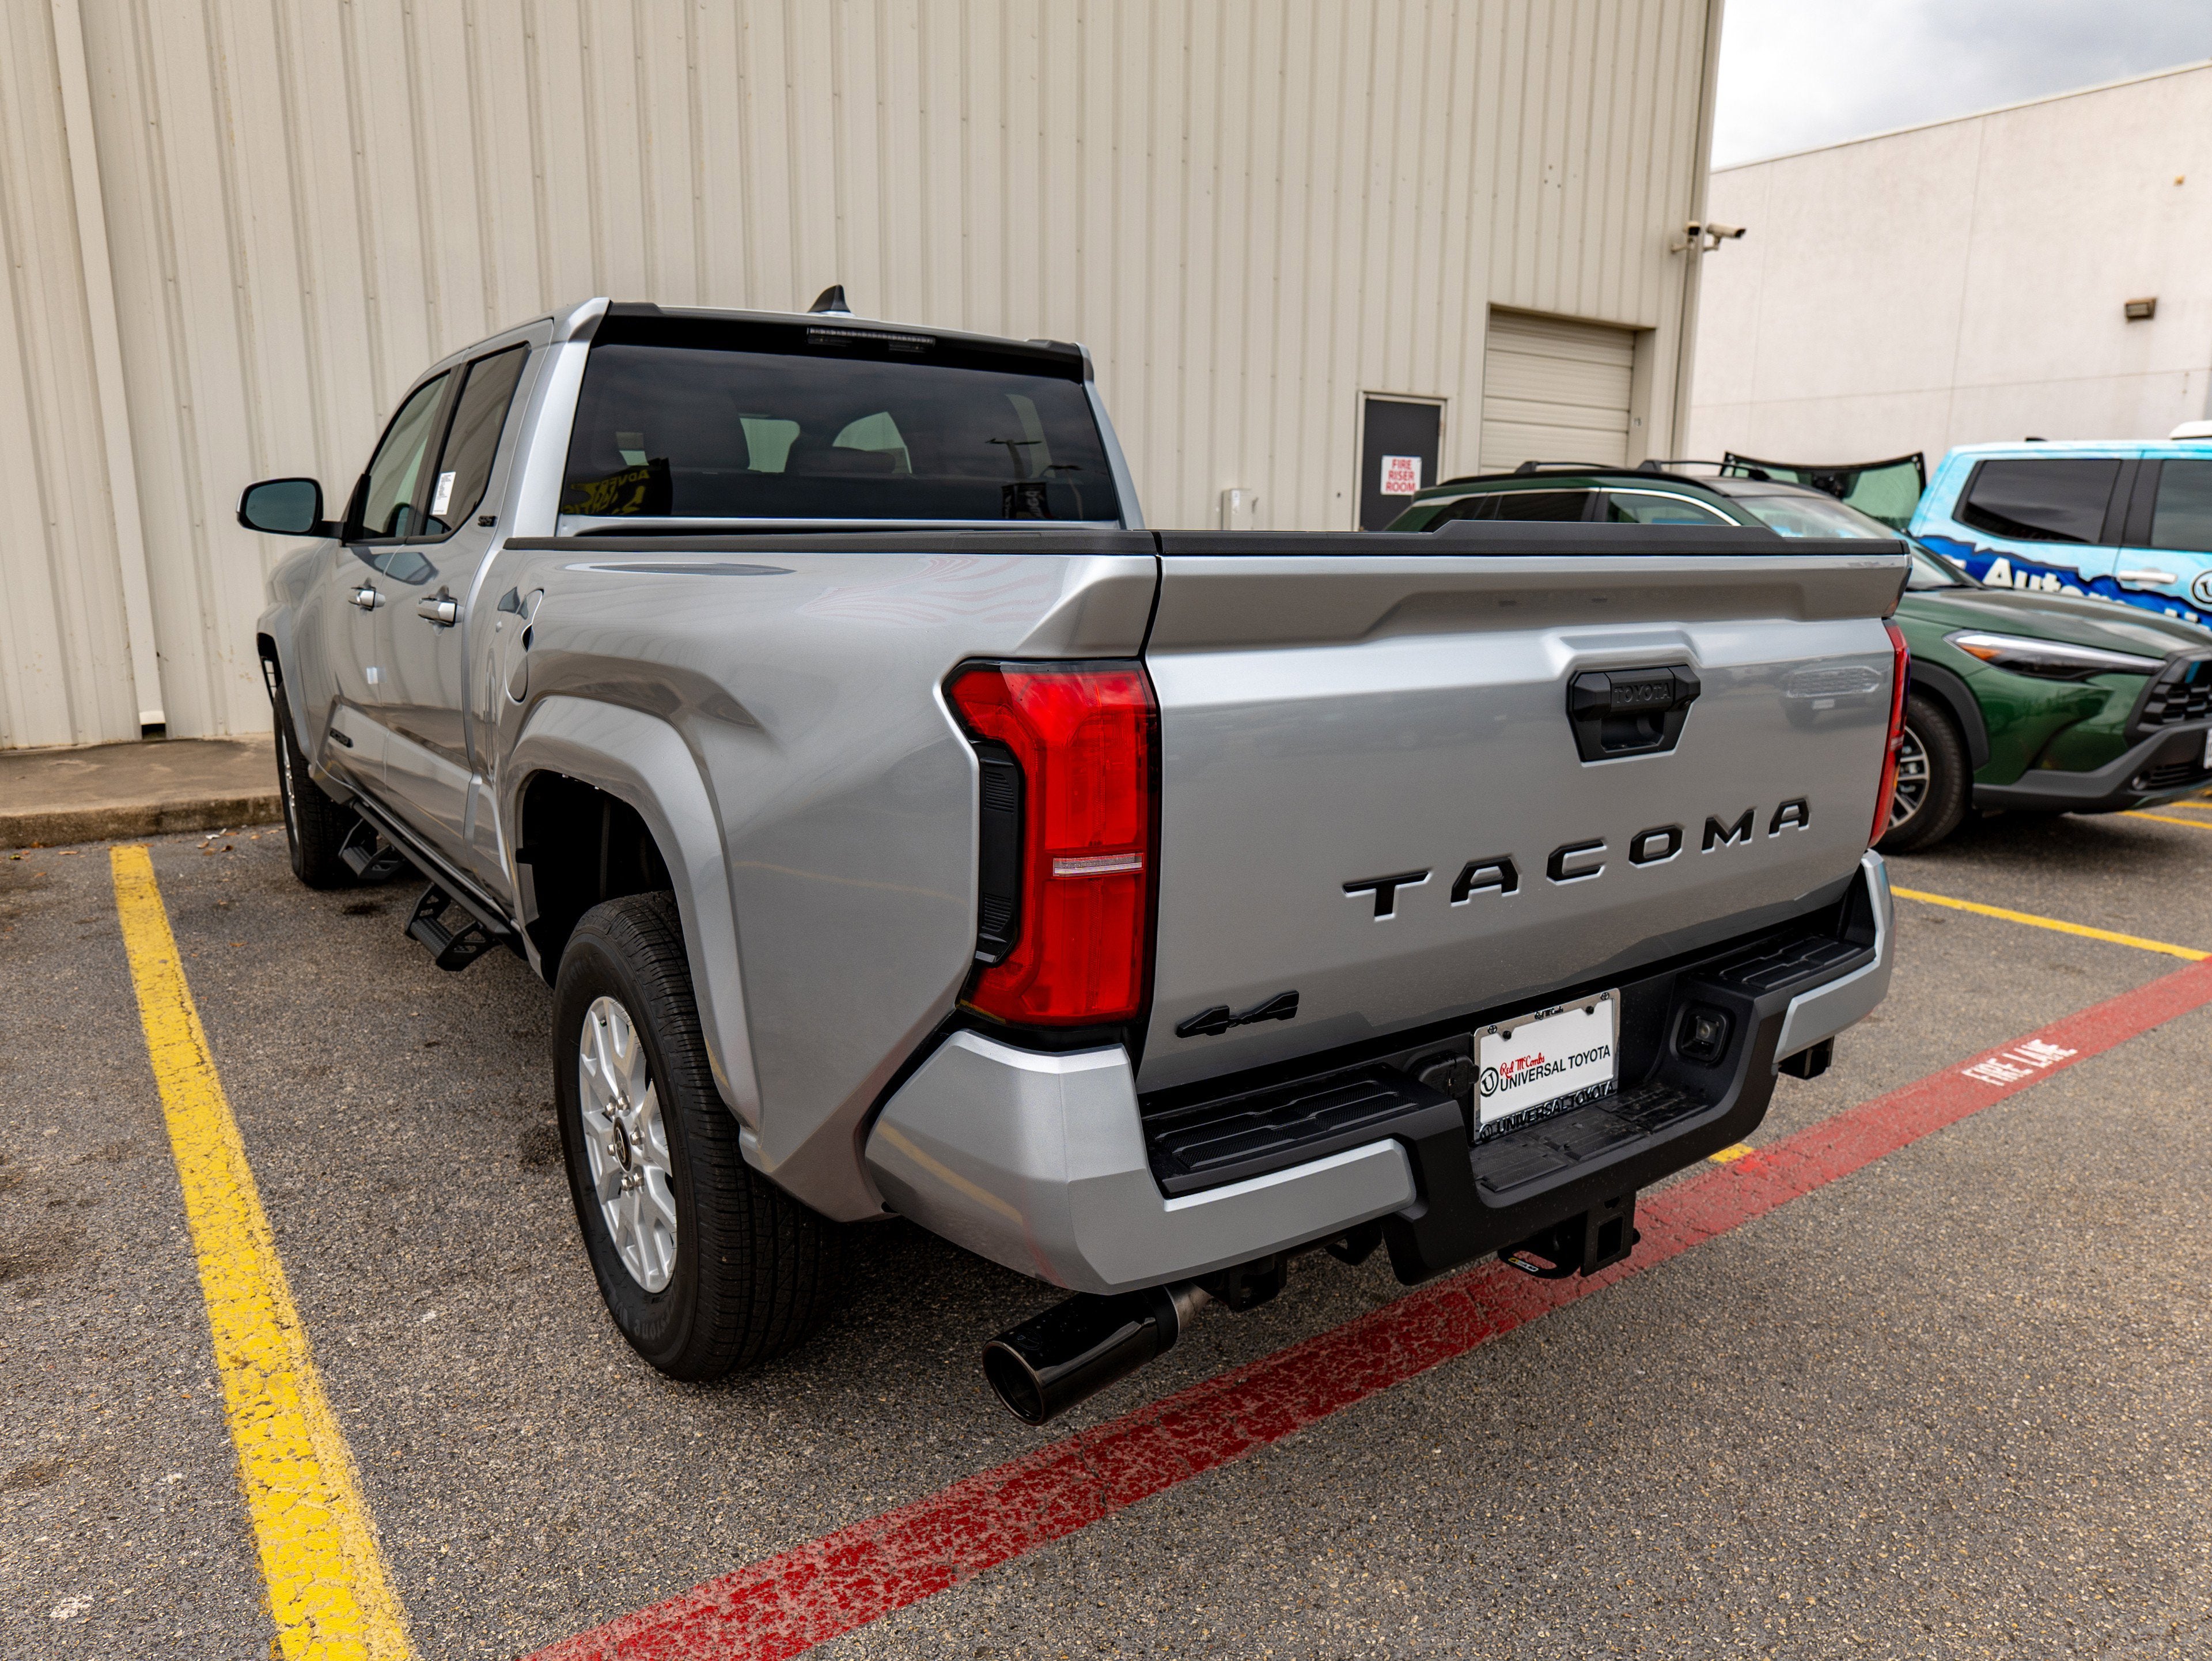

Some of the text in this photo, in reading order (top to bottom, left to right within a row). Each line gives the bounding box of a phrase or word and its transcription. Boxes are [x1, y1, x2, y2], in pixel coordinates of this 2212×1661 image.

[1388, 470, 1414, 480] RISER
[1392, 458, 1411, 470] FIRE
[1385, 481, 1415, 492] ROOM
[1613, 683, 1671, 703] TOYOTA
[1342, 797, 1810, 922] TACOMA
[1500, 1052, 1545, 1079] Red McCombs
[1500, 1059, 1566, 1091] UNIVERSAL
[1568, 1045, 1611, 1069] TOYOTA
[1961, 1039, 2078, 1087] FIRE LANE
[1497, 1097, 1567, 1134] UNIVERSAL
[1568, 1081, 1615, 1107] TOYOTA
